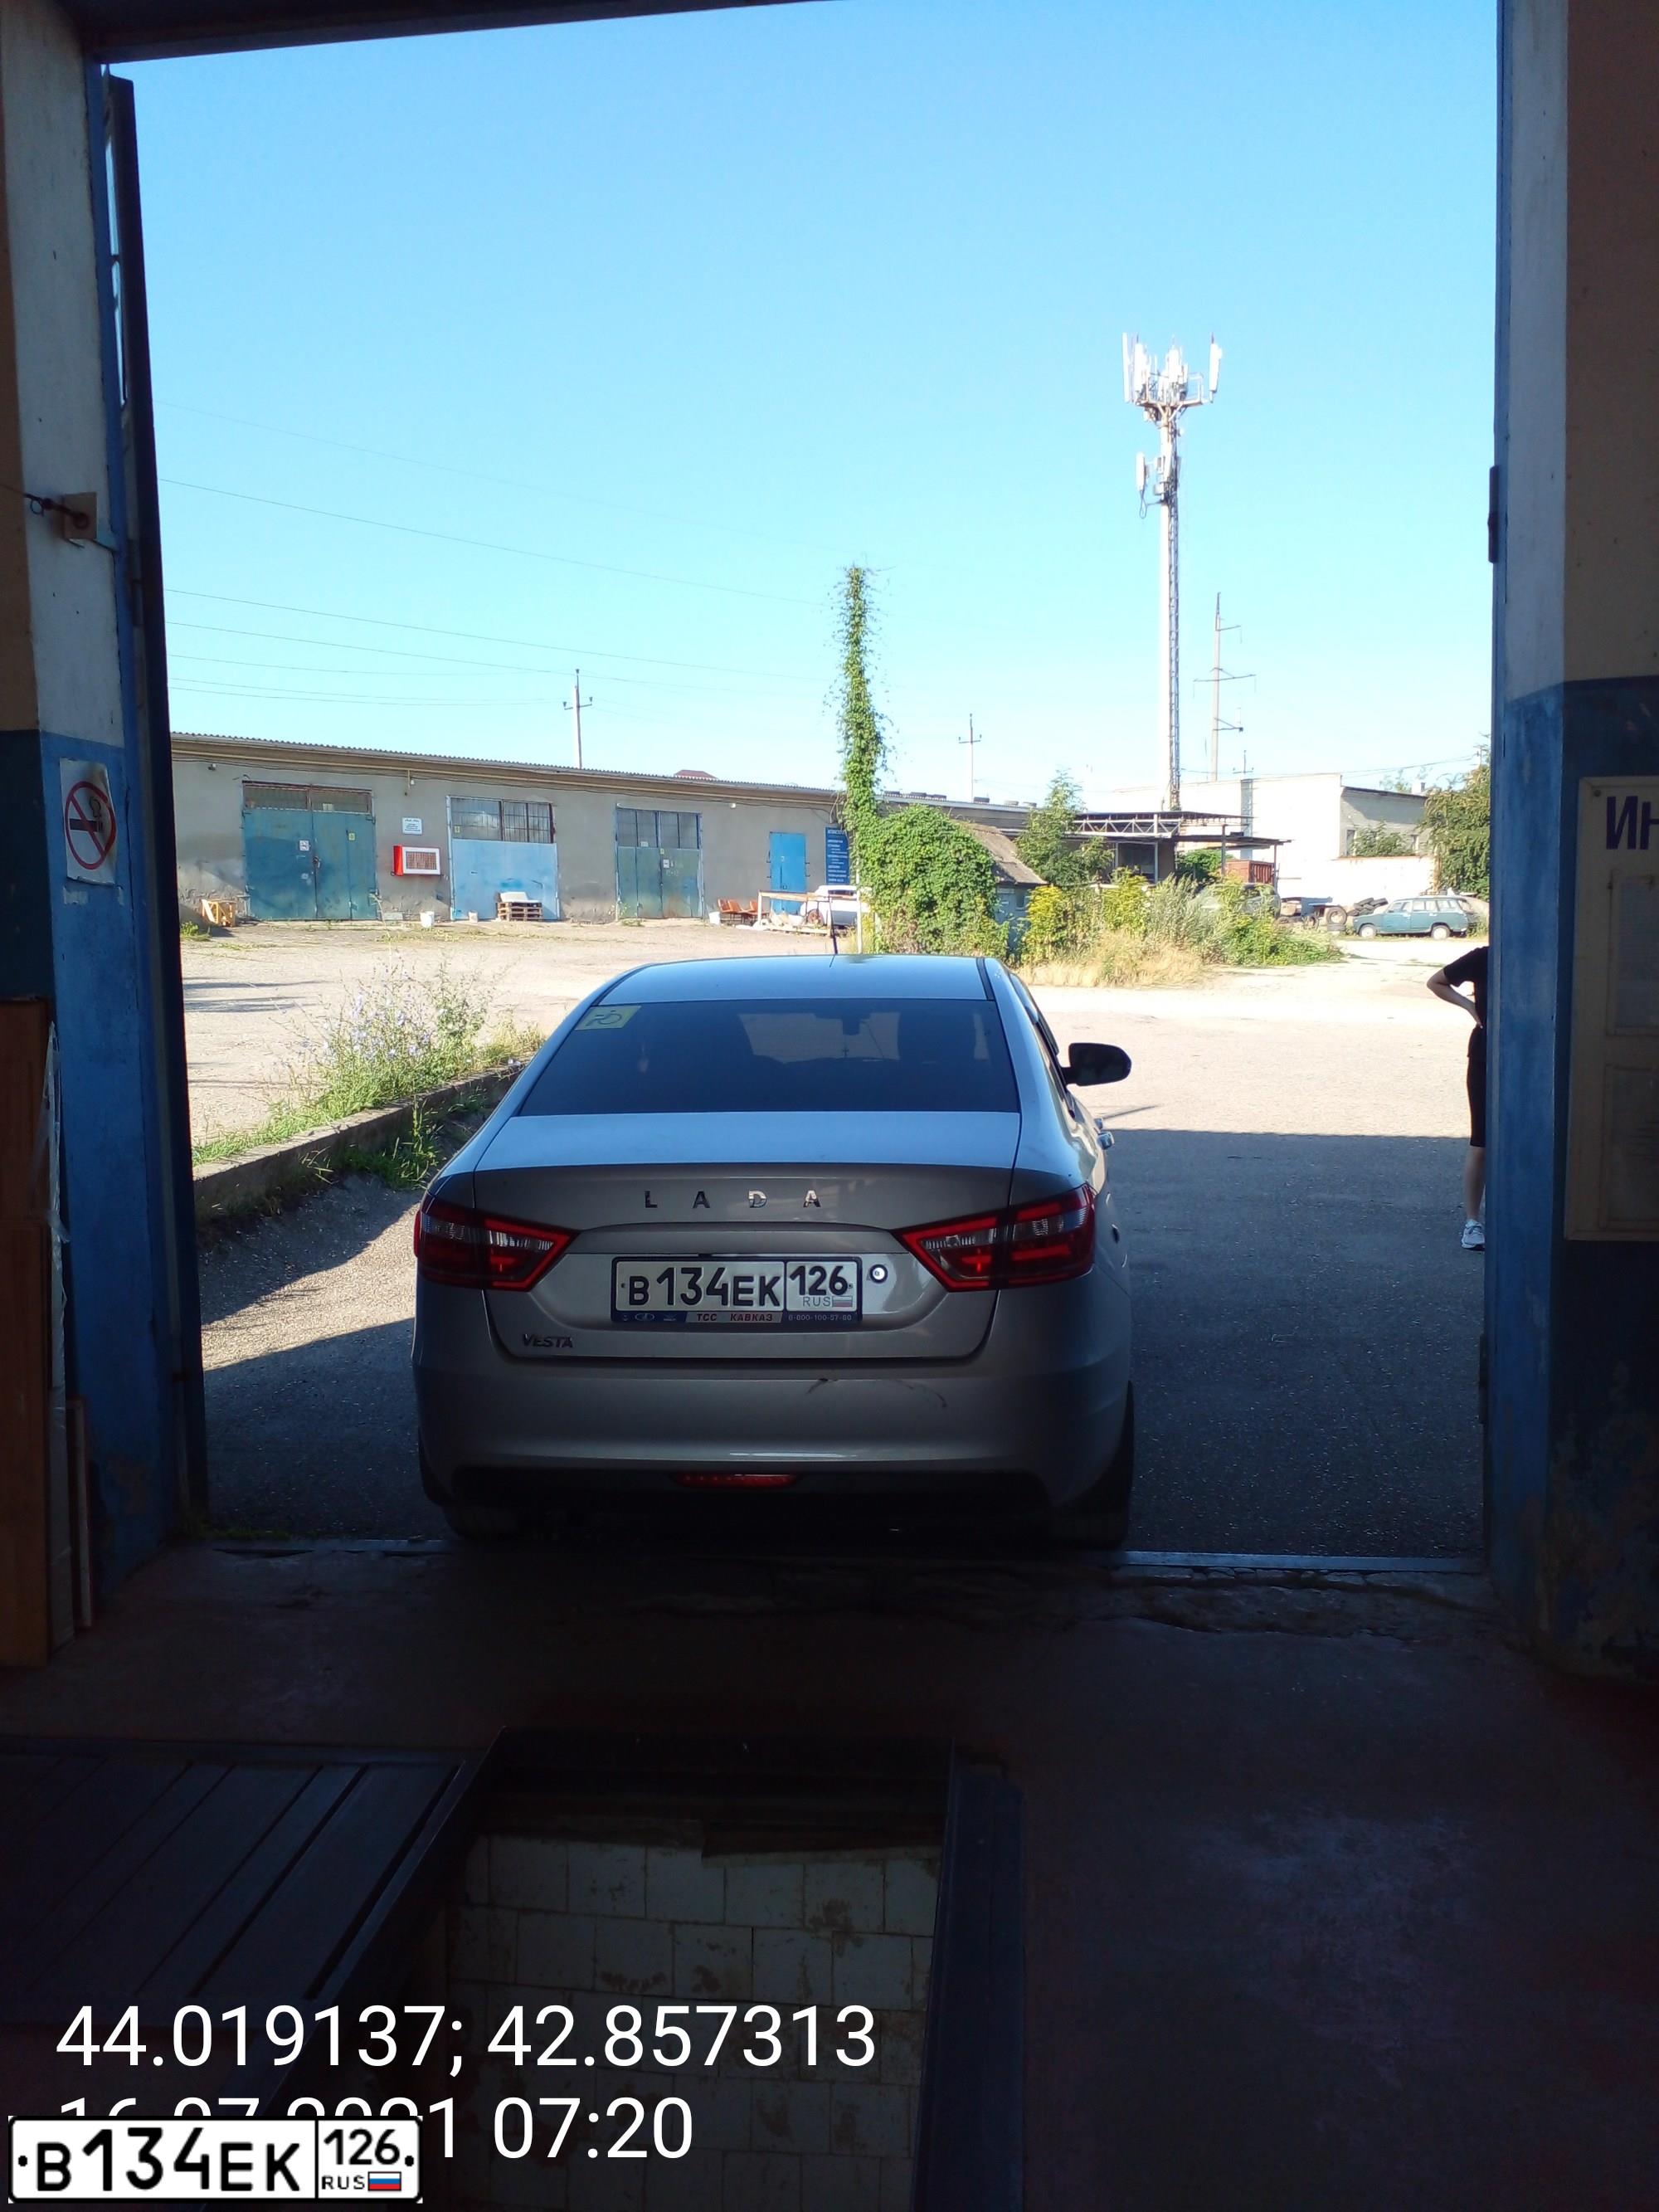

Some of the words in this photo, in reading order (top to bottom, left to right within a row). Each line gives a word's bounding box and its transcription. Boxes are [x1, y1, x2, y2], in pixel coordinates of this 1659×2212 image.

[645, 1190, 820, 1209] LADA
[629, 1267, 780, 1307] В134ЕК
[790, 1265, 848, 1296] 126
[803, 1296, 830, 1308] RUS
[697, 1313, 718, 1322] ТСС
[730, 1313, 773, 1322] КАВКАЗ
[522, 1333, 573, 1348] VESTA
